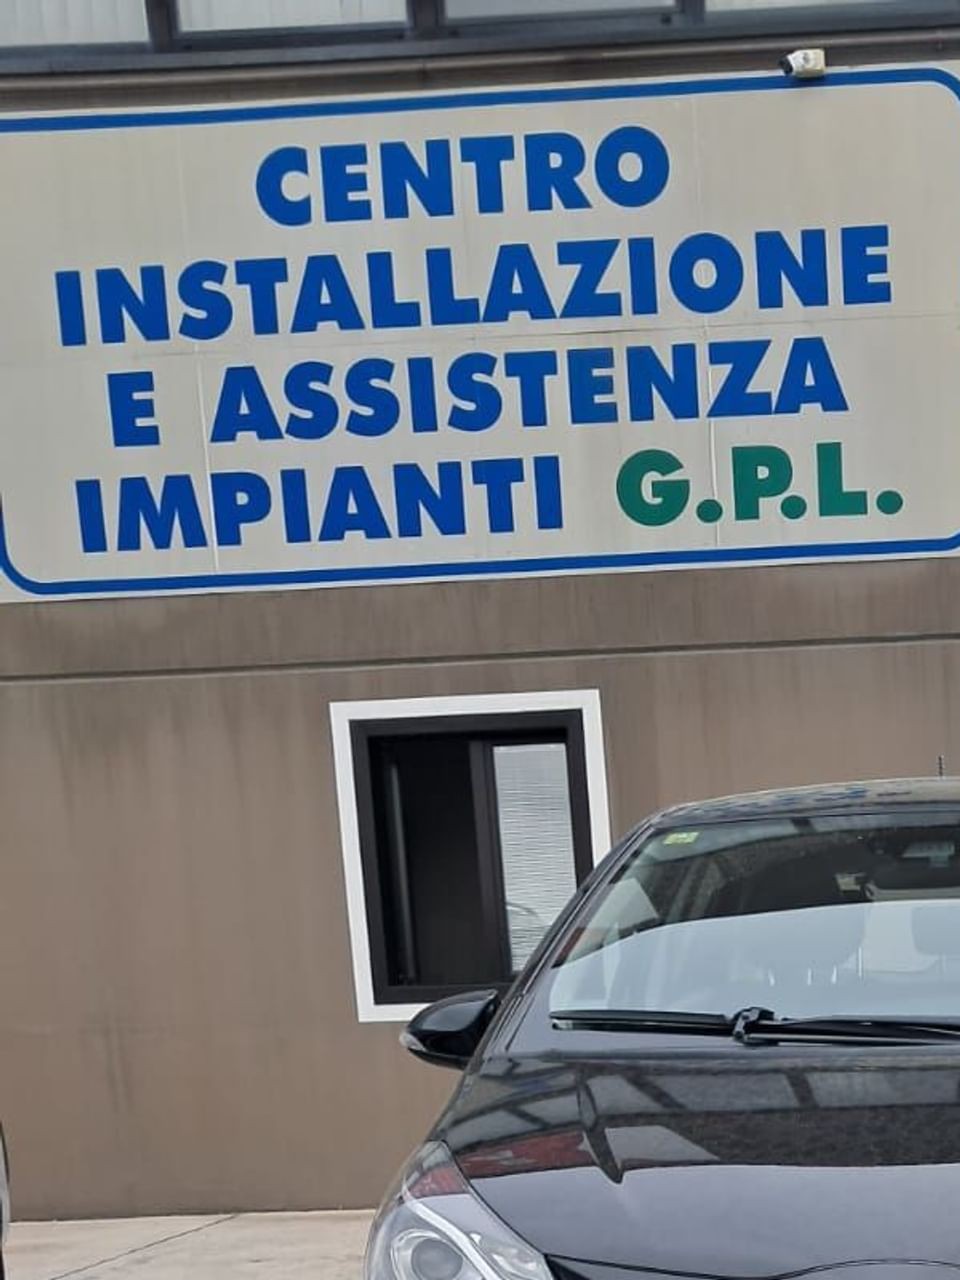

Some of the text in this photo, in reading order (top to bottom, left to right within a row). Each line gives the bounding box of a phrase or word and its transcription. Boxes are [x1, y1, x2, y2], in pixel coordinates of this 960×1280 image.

[256, 126, 670, 226] CENTRO
[55, 225, 892, 347] INSTALLAZIONE
[107, 337, 849, 447] E ASSISTENZA
[76, 442, 904, 553] IMPIANTI G.P.L.
